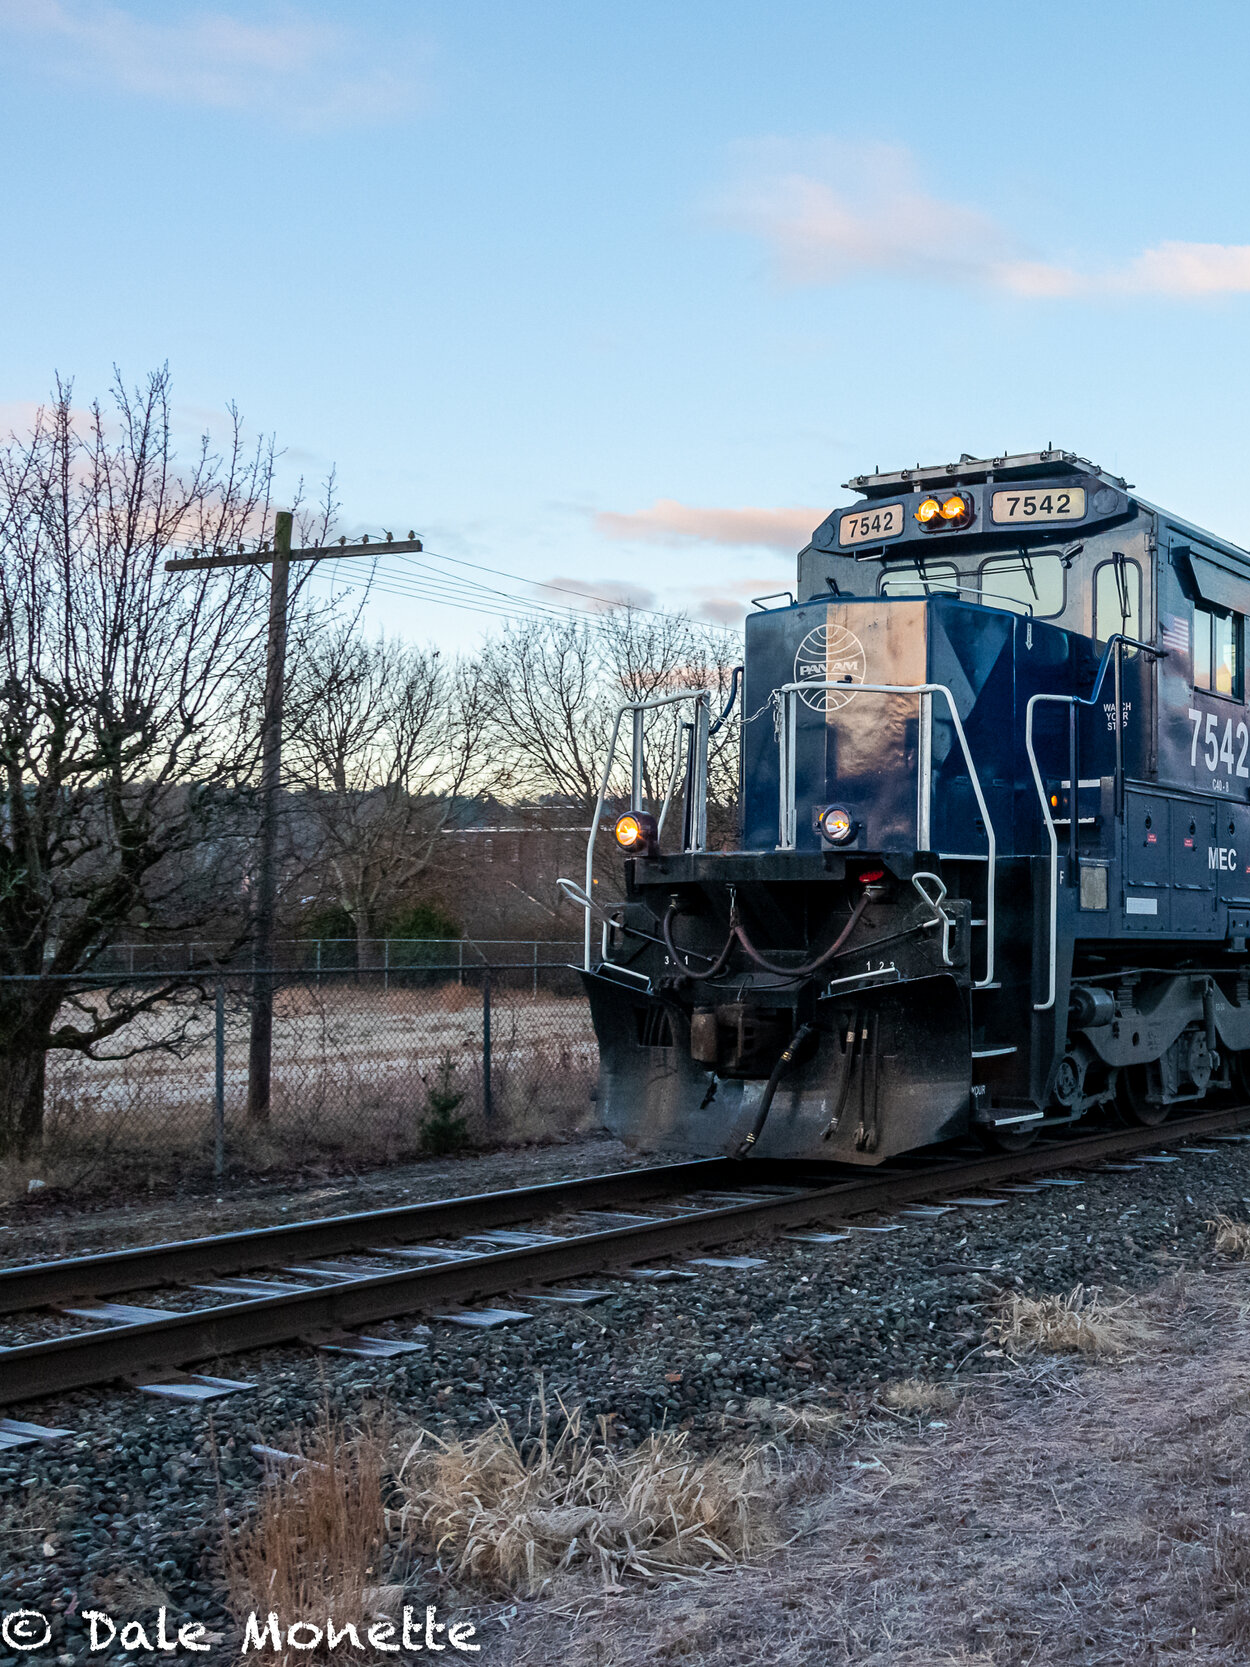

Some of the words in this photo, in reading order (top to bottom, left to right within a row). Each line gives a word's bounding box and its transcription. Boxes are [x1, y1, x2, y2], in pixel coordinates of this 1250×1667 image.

[1006, 493, 1072, 517] 7542
[849, 511, 894, 539] 7542
[799, 663, 828, 676] PAN
[830, 661, 858, 673] AM
[1103, 702, 1132, 713] WAH
[1106, 711, 1129, 722] YOR
[1107, 721, 1128, 731] STP
[1188, 708, 1250, 778] 7542
[1208, 846, 1238, 873] MEC
